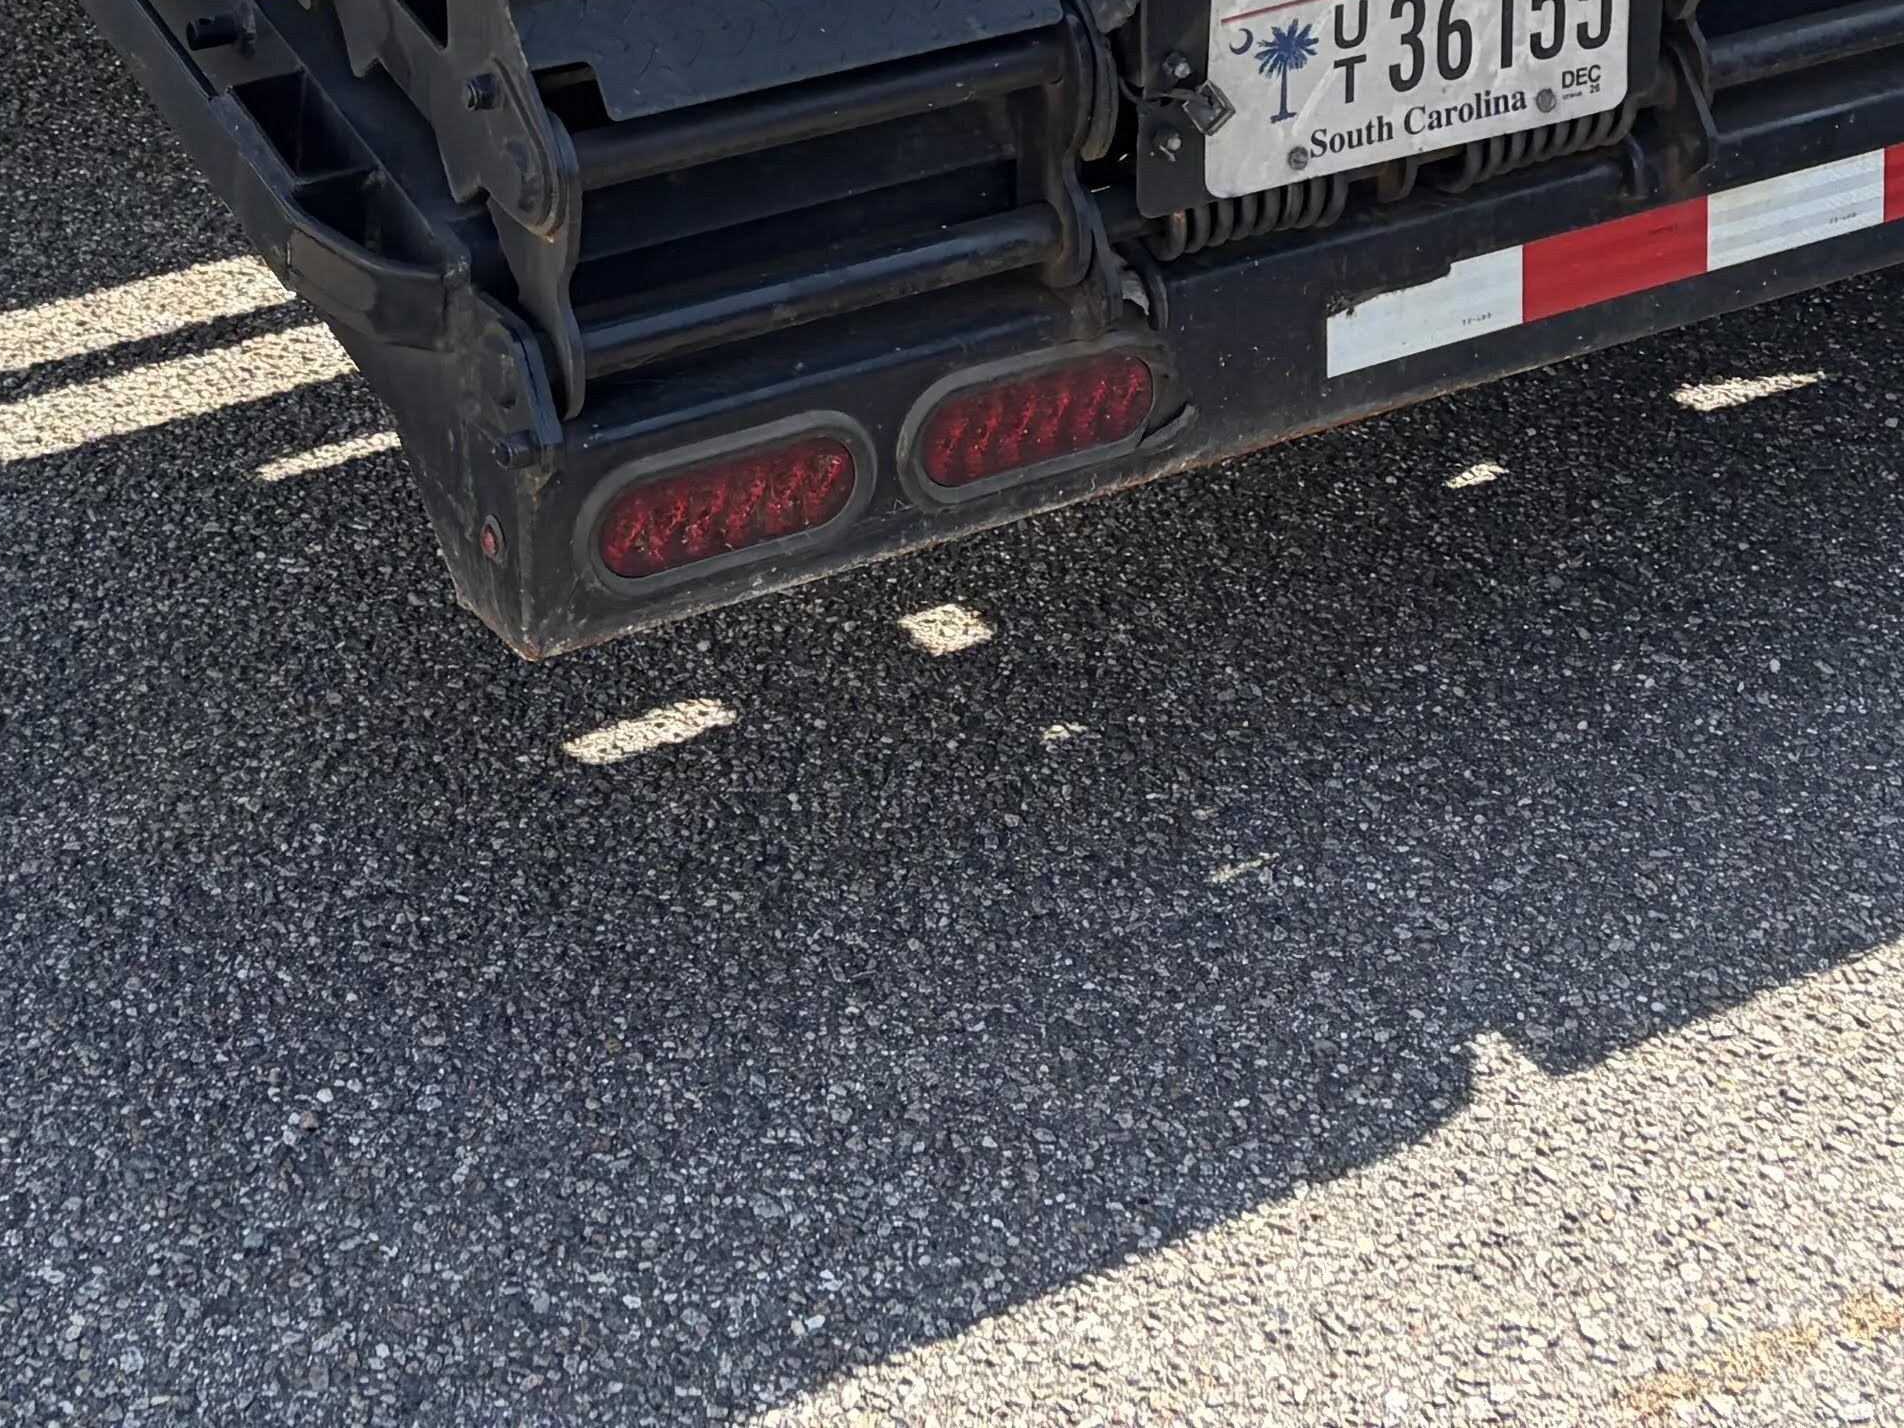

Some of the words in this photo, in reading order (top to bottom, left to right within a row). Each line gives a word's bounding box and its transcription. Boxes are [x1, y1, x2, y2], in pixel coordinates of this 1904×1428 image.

[1561, 64, 1602, 90] DEC
[1309, 115, 1394, 160] South
[1403, 89, 1528, 136] Carolina
